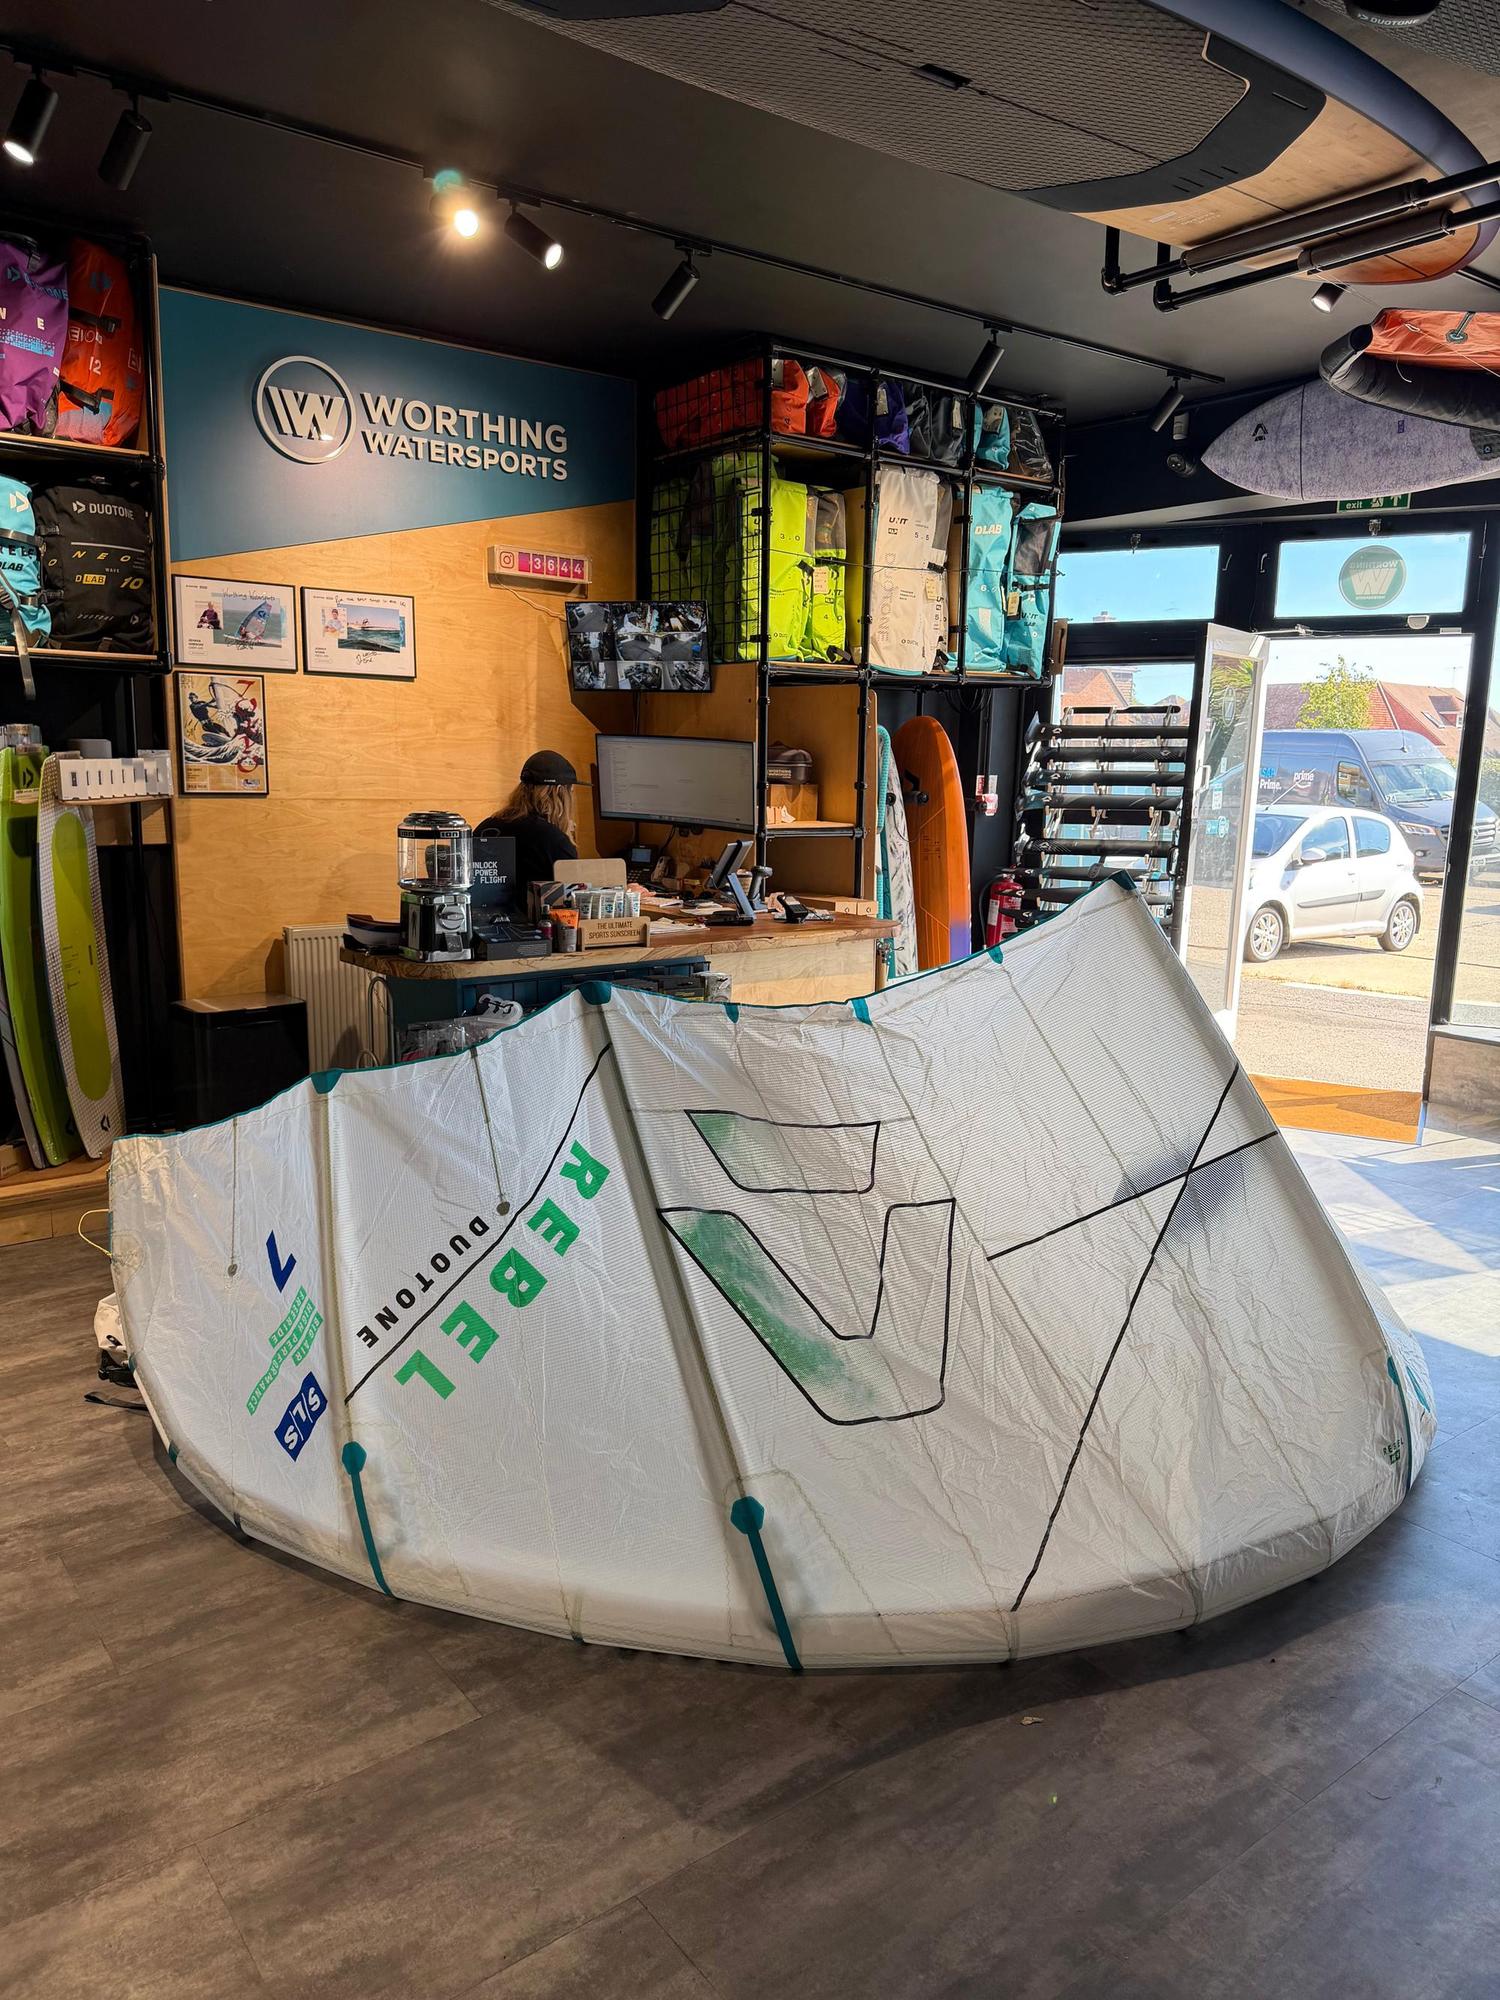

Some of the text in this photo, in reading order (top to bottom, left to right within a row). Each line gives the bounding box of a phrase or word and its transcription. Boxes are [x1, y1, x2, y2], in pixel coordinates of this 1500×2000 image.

[361, 392, 568, 453] WORTHING
[362, 429, 568, 481] WATERSPORTS
[89, 503, 134, 520] DUOTONE
[1345, 501, 1363, 510] exit
[780, 533, 801, 541] 3.0
[974, 524, 1003, 535] DLAB
[533, 557, 582, 575] 3644
[120, 576, 144, 590] 10
[1294, 769, 1315, 781] prime
[474, 869, 498, 877] POWER
[480, 876, 508, 884] FLIGHT
[597, 921, 633, 930] THE ULTIMATE
[588, 929, 641, 940] SPORTS SUNSCREEN
[393, 1139, 611, 1401] REBEL
[356, 1216, 490, 1349] DUOTONE
[271, 1289, 305, 1346] FREERIDE
[295, 1316, 321, 1361] BIG AIR
[248, 1301, 314, 1412] HIGH PERFORMANCE
